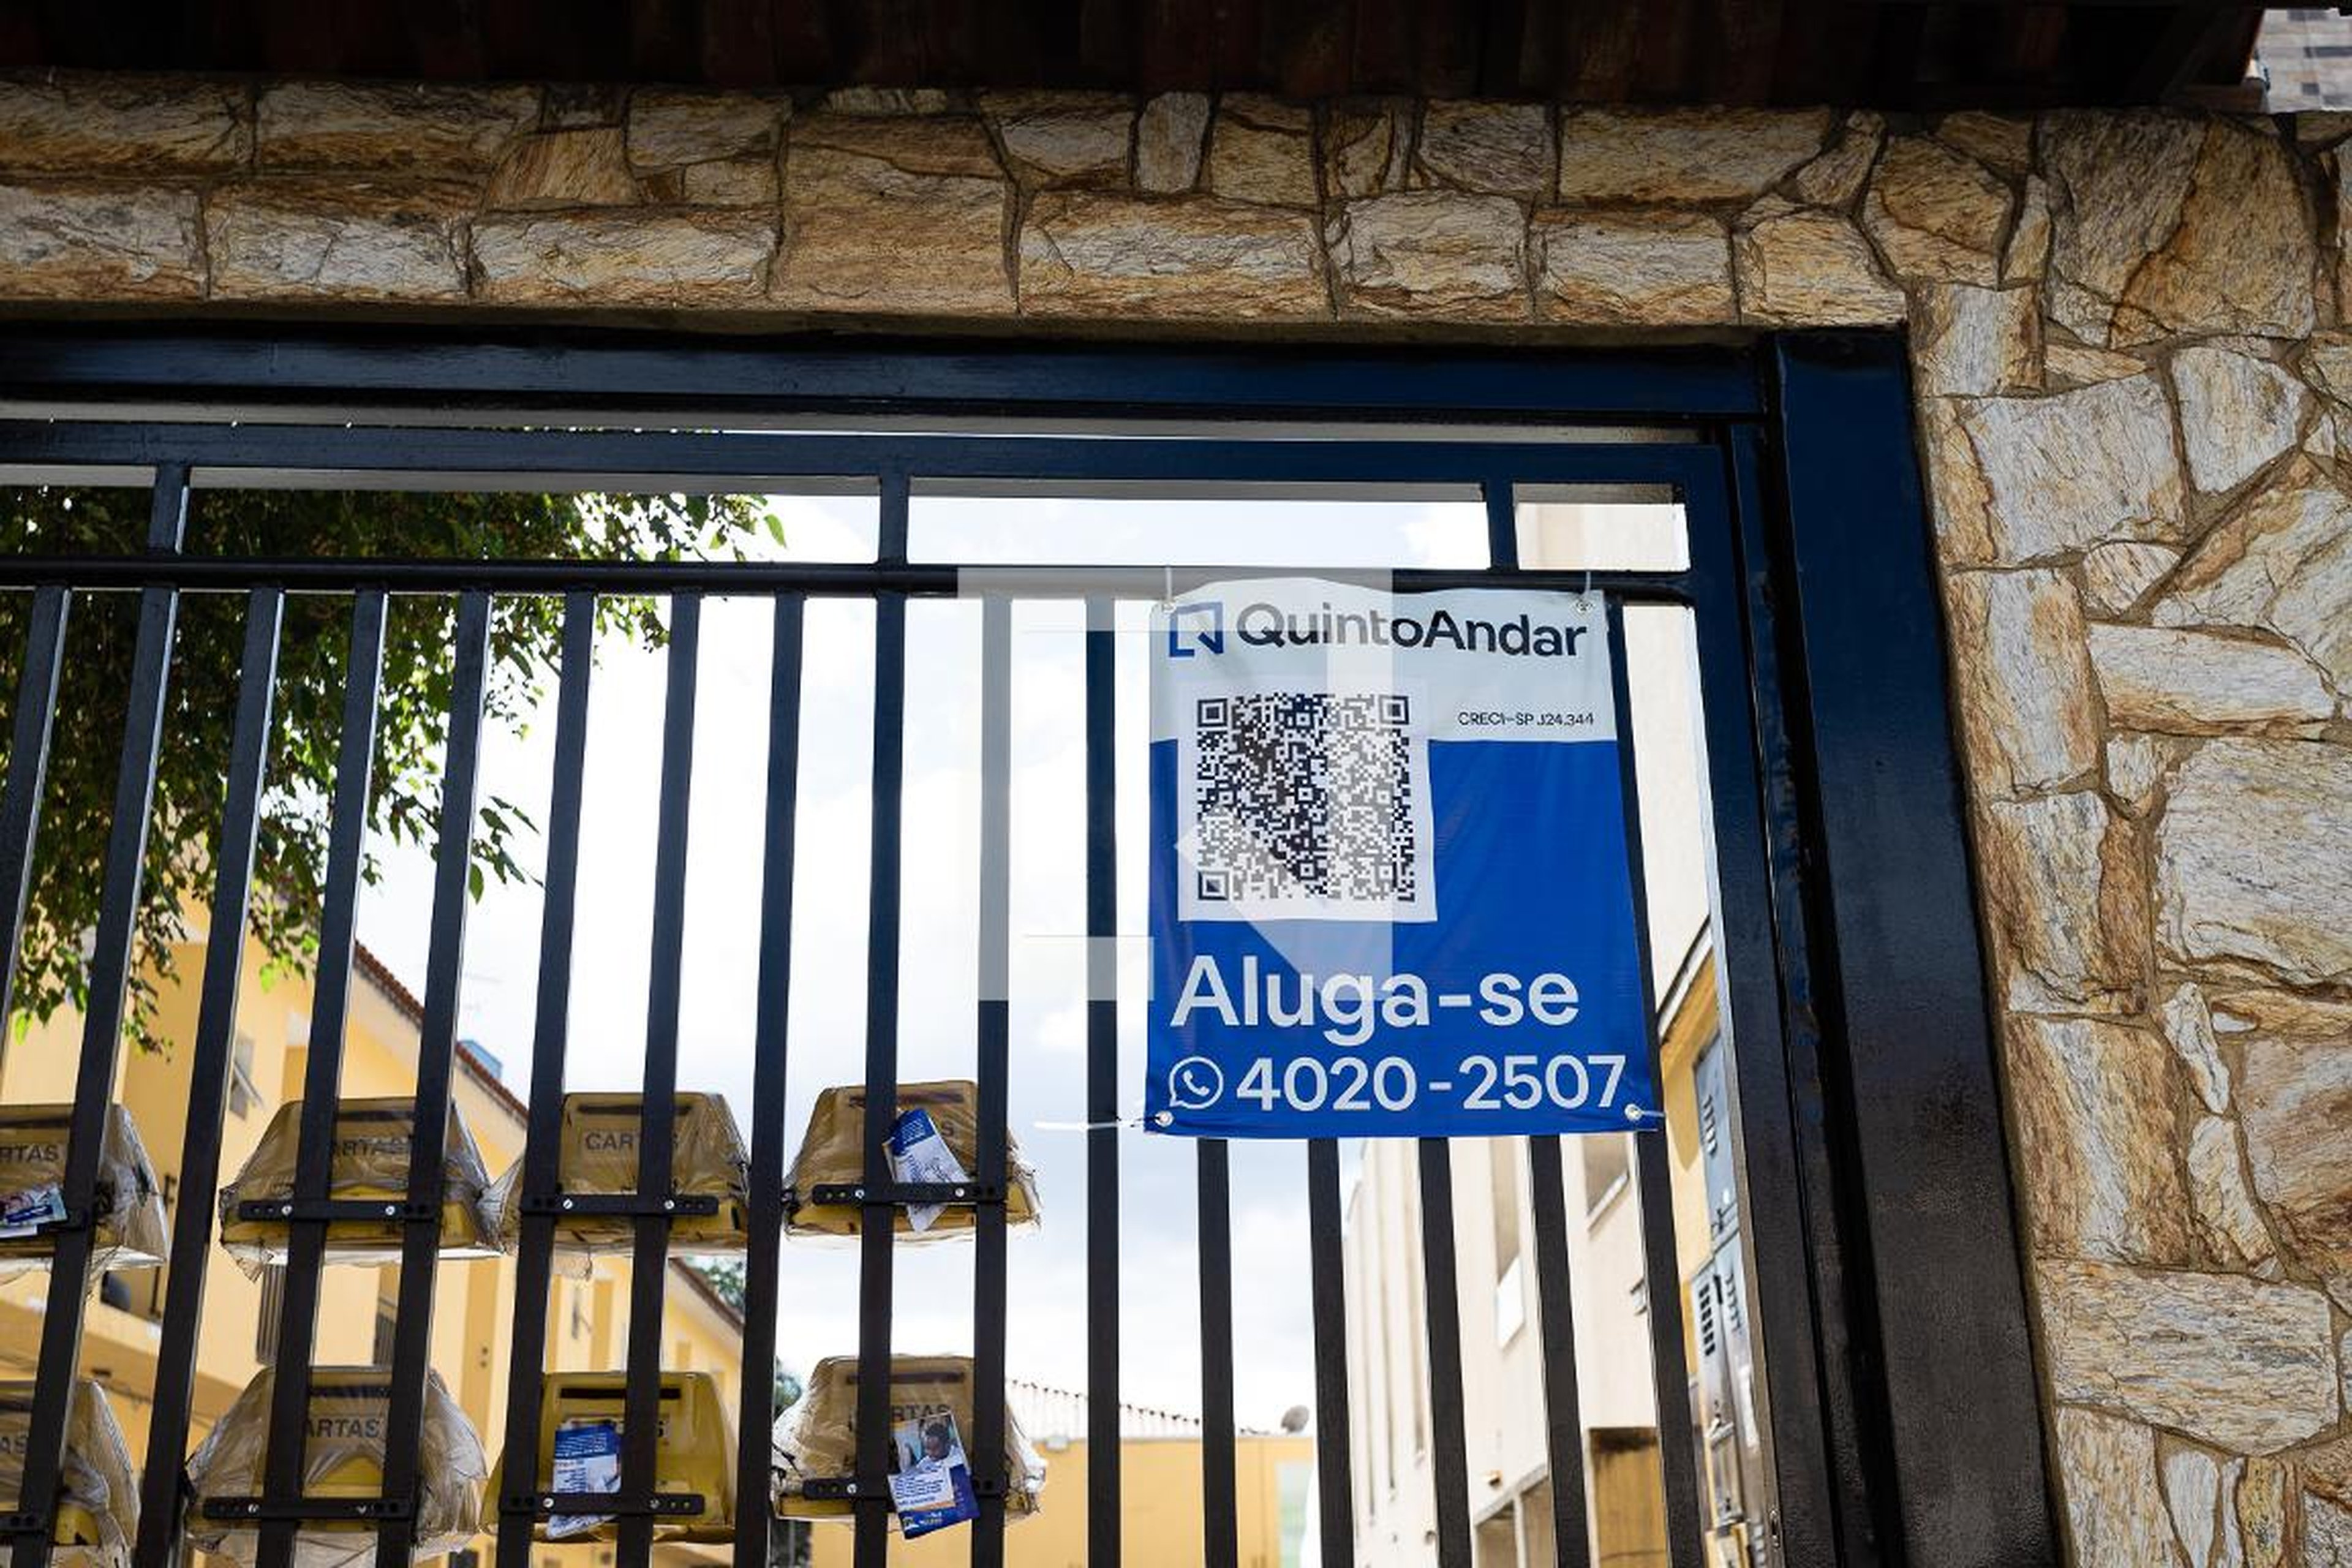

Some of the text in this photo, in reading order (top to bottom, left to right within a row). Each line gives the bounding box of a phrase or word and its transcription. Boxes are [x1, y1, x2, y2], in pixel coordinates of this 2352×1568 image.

[1236, 602, 1588, 658] QuintoAndar
[1457, 711, 1534, 726] CRECI-SP
[1170, 955, 1579, 1047] Aluga-se
[1236, 1054, 1627, 1112] 4020-2507
